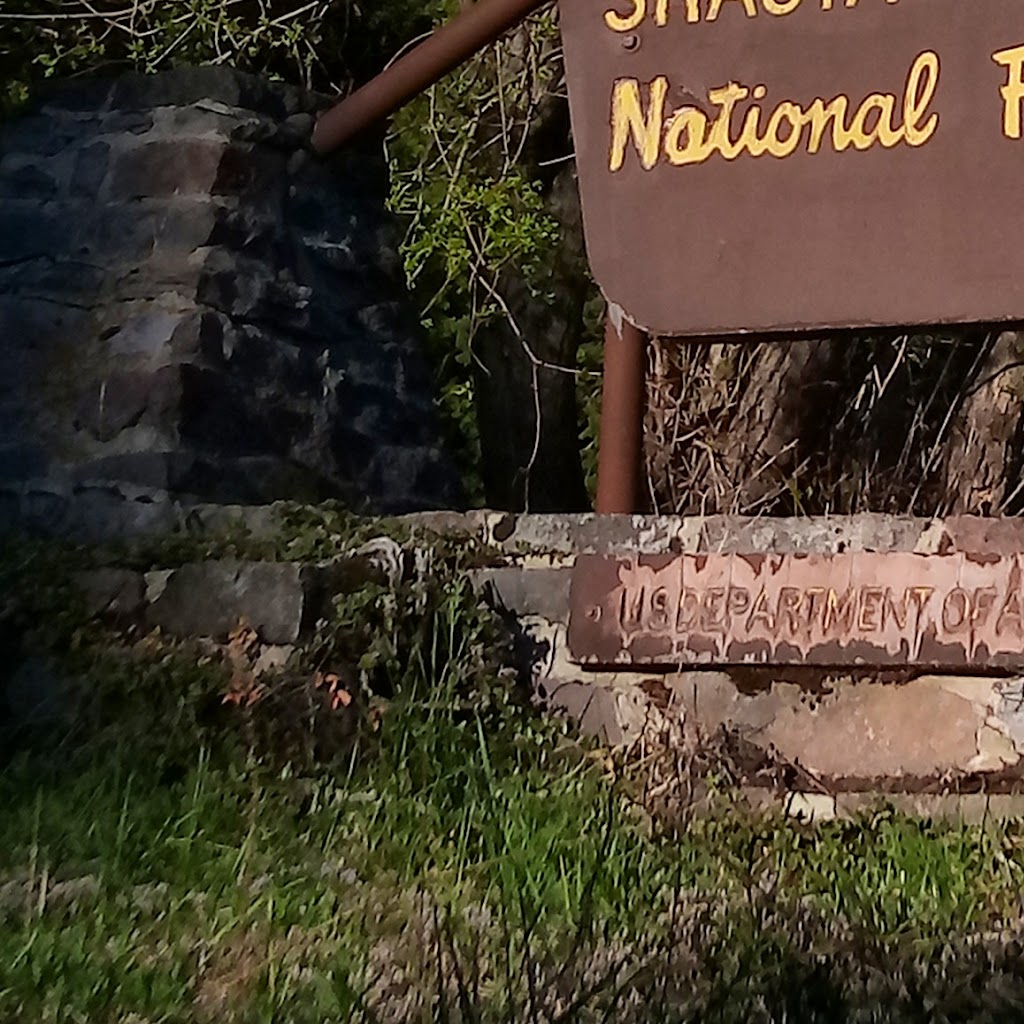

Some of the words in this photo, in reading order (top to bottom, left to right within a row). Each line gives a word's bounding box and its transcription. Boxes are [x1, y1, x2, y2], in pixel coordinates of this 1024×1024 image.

[607, 49, 941, 173] National
[675, 586, 936, 634] DEPARTMENT
[942, 586, 998, 634] OF
